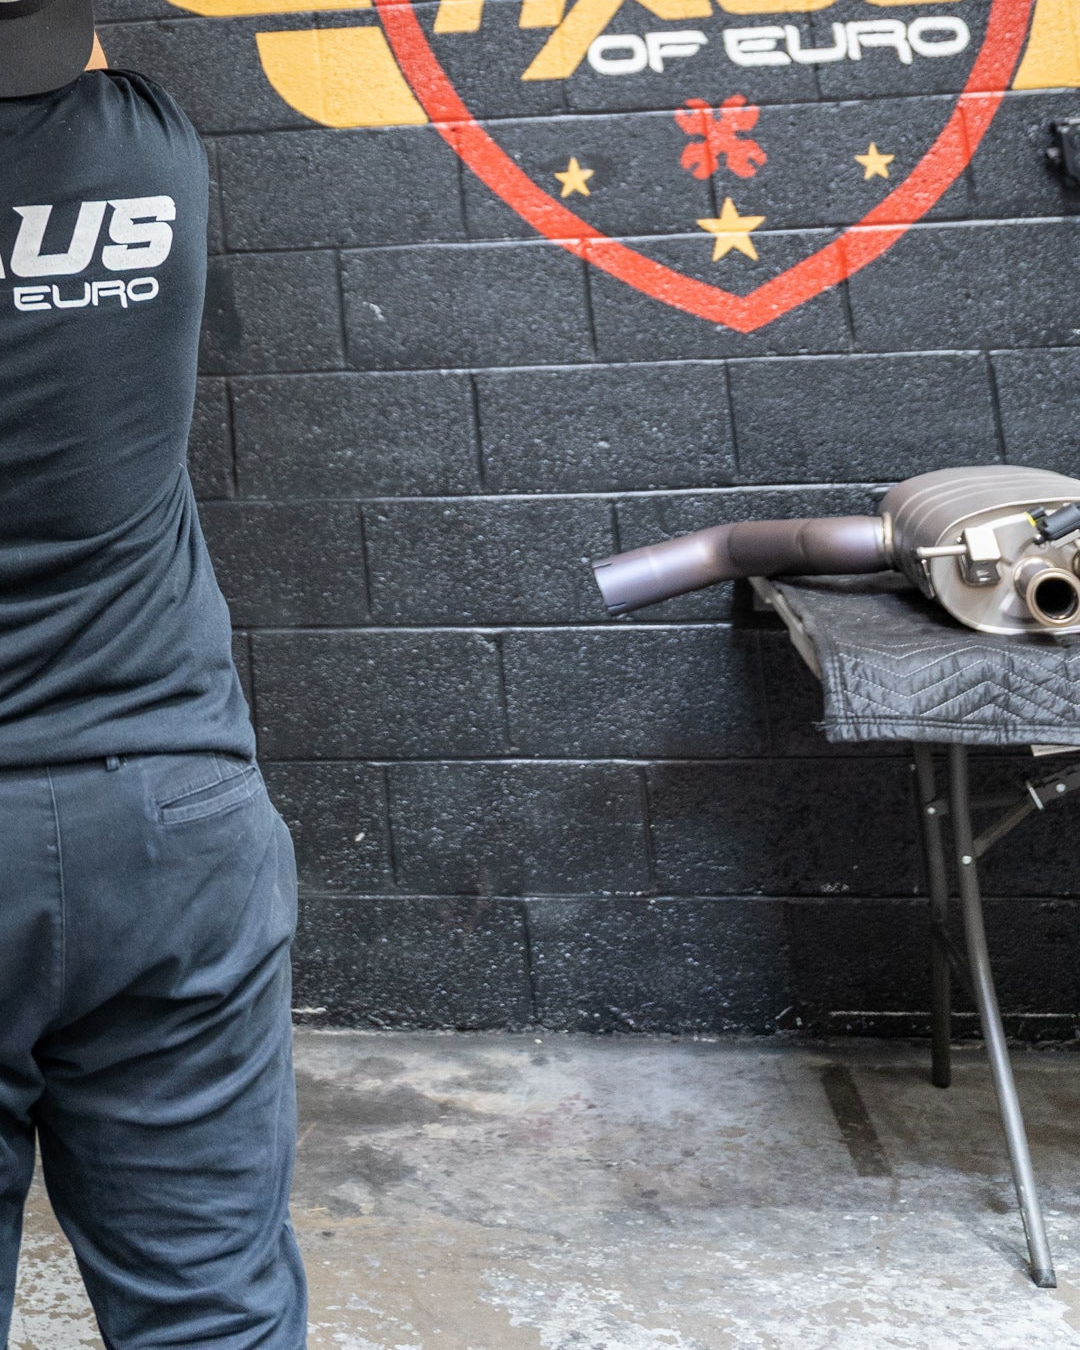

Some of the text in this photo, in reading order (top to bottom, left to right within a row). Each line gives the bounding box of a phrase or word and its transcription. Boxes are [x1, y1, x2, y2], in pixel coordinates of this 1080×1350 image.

[588, 15, 970, 76] OF EURO
[13, 276, 159, 312] EURO
